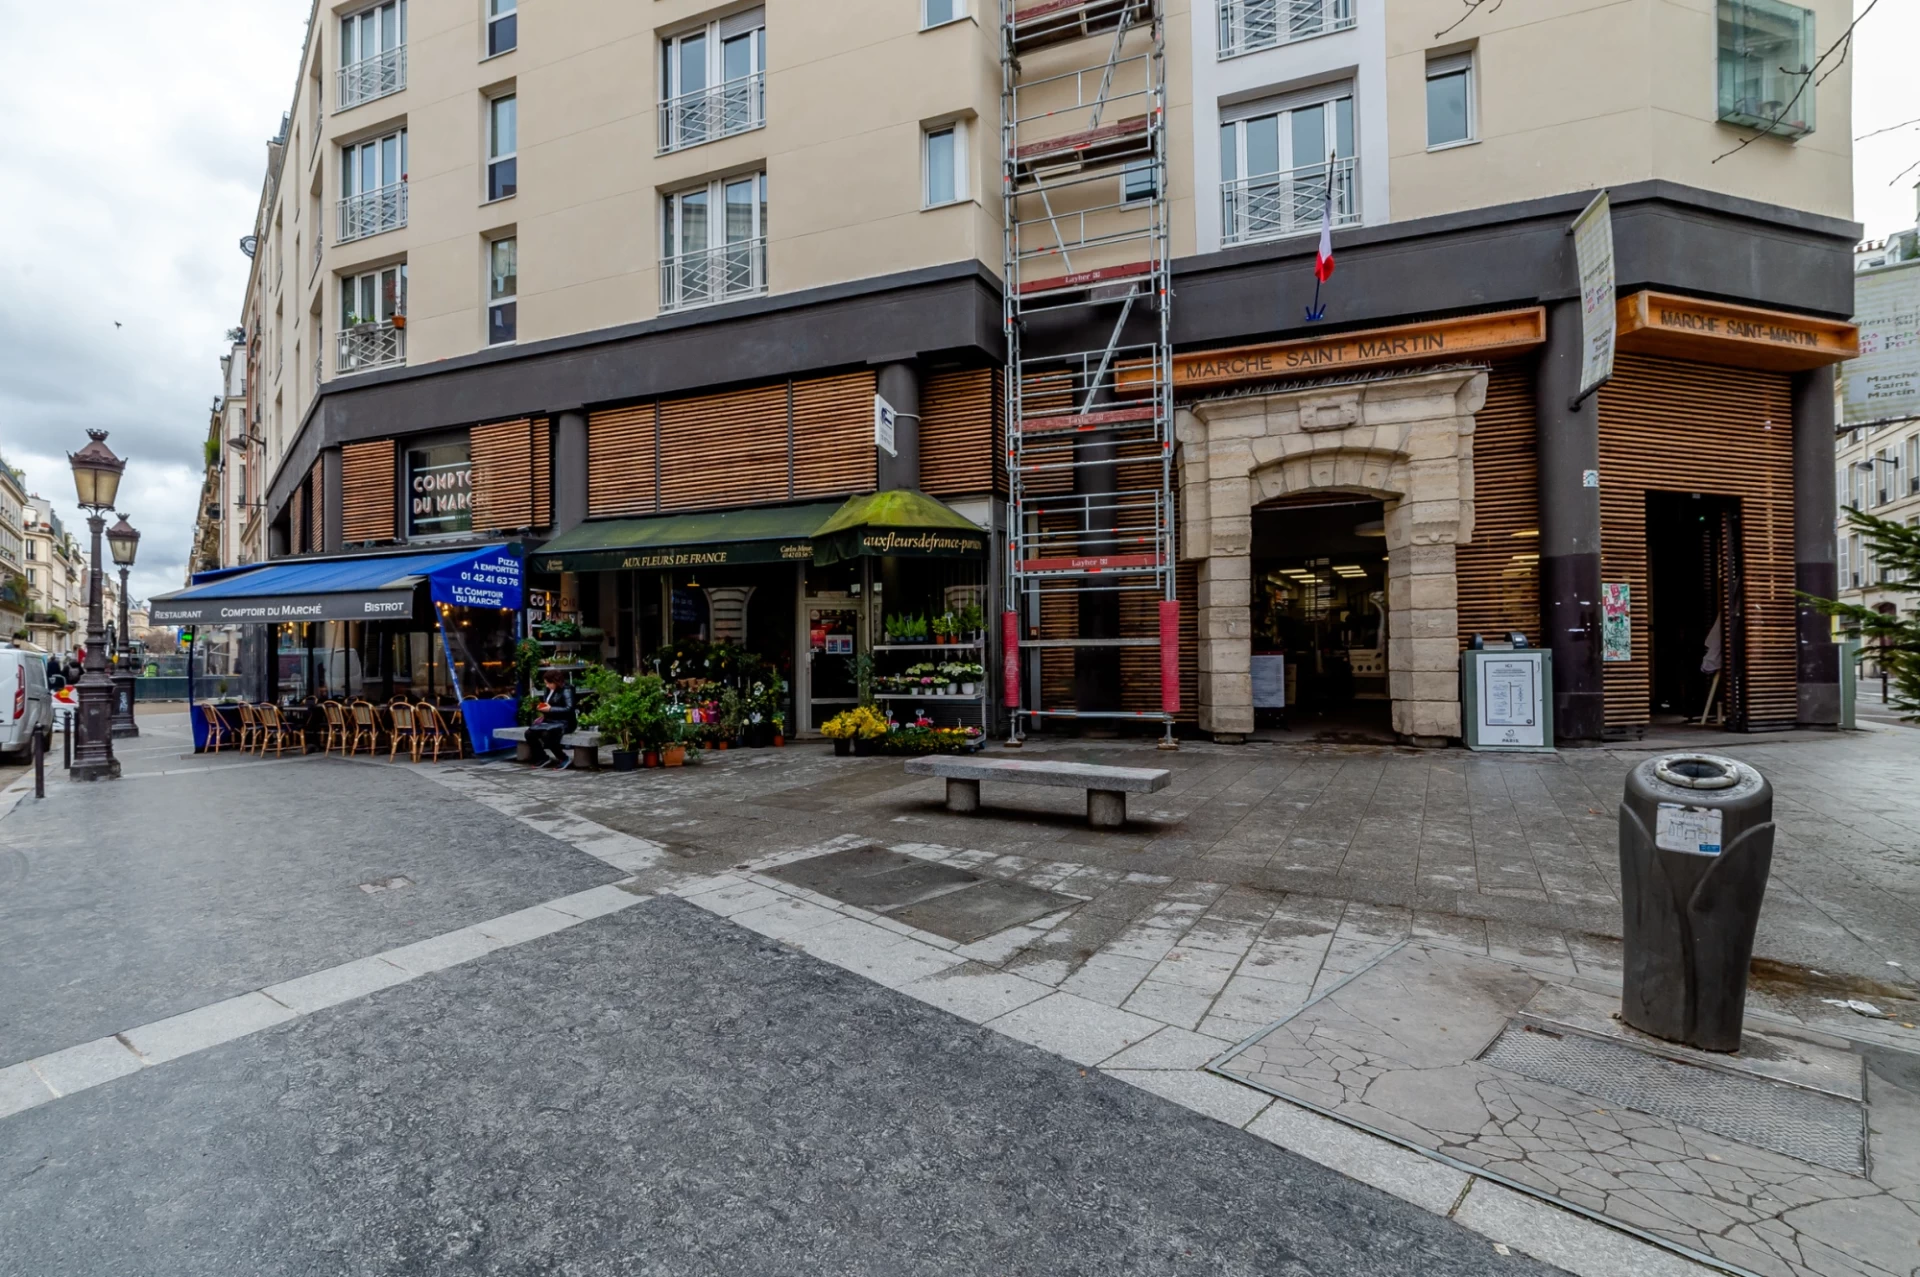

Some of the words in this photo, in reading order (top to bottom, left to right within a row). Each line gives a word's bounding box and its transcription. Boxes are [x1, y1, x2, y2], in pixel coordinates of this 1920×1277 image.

[1065, 273, 1091, 283] Layher
[1726, 319, 1819, 346] SAINT-MARTIN
[1186, 354, 1272, 379] MARCHE
[1286, 345, 1347, 367] SAINT
[1358, 332, 1444, 359] MARTIN
[1866, 371, 1919, 383] Marché
[1874, 381, 1911, 390] Saint
[1868, 387, 1916, 399] Martin
[413, 469, 472, 493] COMPTO
[413, 496, 432, 515] DU
[436, 491, 472, 512] MARC
[498, 557, 519, 567] PIZZA
[622, 557, 640, 568] AUX
[642, 554, 674, 567] FLEURS
[675, 553, 689, 565] DE
[689, 551, 727, 564] FRANCE
[1071, 559, 1098, 567] Layher
[473, 561, 479, 570] À
[480, 563, 519, 575] EMPORTER
[461, 571, 471, 580] 01
[473, 573, 484, 582] 42
[485, 575, 495, 583] 41
[496, 576, 507, 585] 63
[508, 577, 519, 586] 76
[452, 585, 463, 594] LE
[464, 587, 503, 599] COMPTOIR
[456, 595, 467, 603] DU
[220, 607, 266, 617] COMPTOIR
[267, 607, 280, 616] DU
[281, 603, 322, 615] MARCHÉ
[364, 601, 405, 613] BISTROT
[154, 610, 202, 619] RESTAURANT
